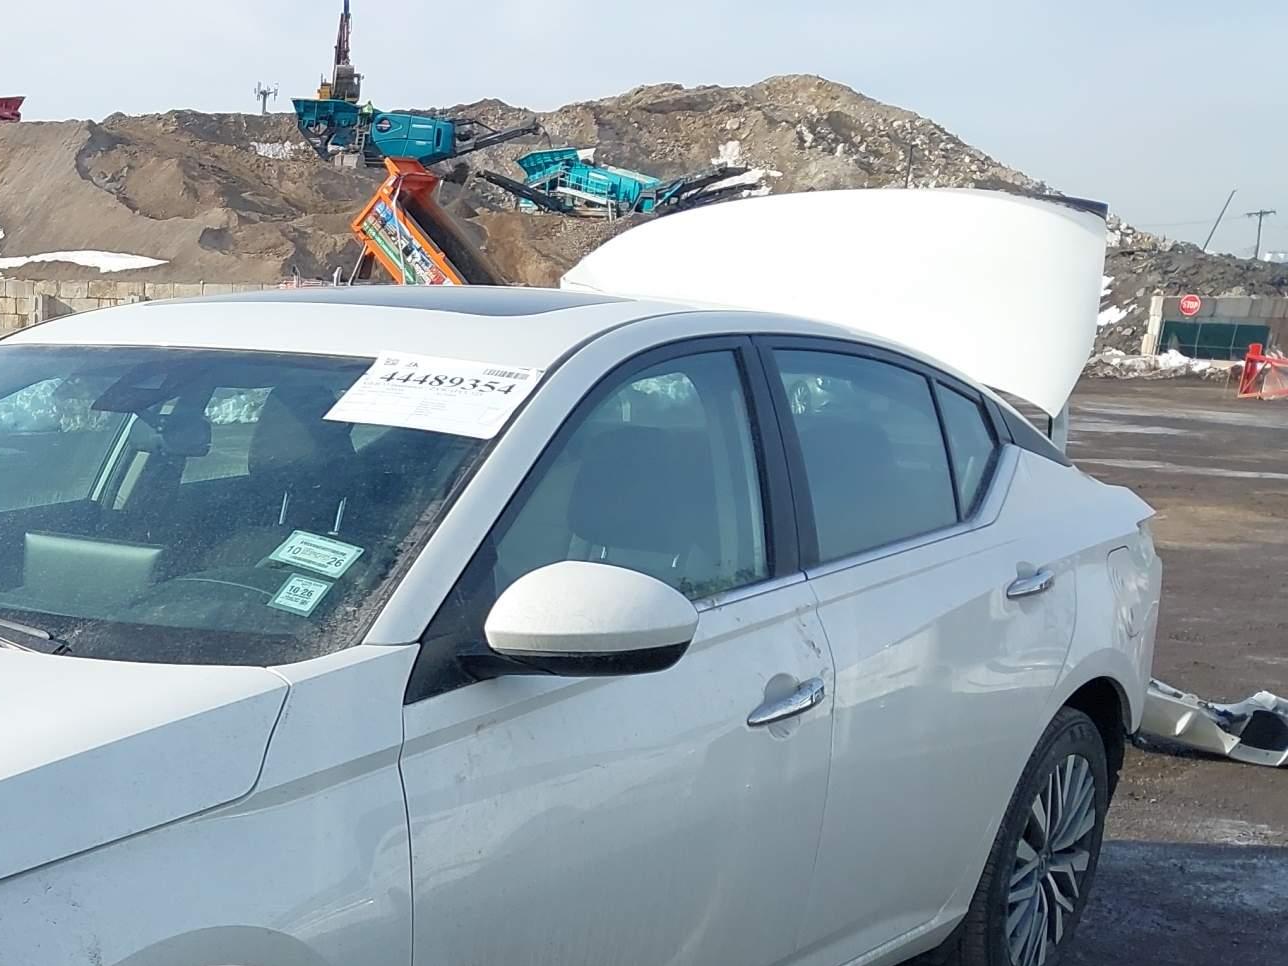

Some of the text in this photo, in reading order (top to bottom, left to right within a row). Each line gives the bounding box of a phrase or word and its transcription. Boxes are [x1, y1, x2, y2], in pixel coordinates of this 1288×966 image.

[1182, 300, 1198, 310] STOP
[379, 371, 517, 395] 44489354
[287, 545, 302, 555] 10
[327, 557, 344, 568] 26
[288, 585, 299, 594] 10
[301, 588, 314, 597] 26
